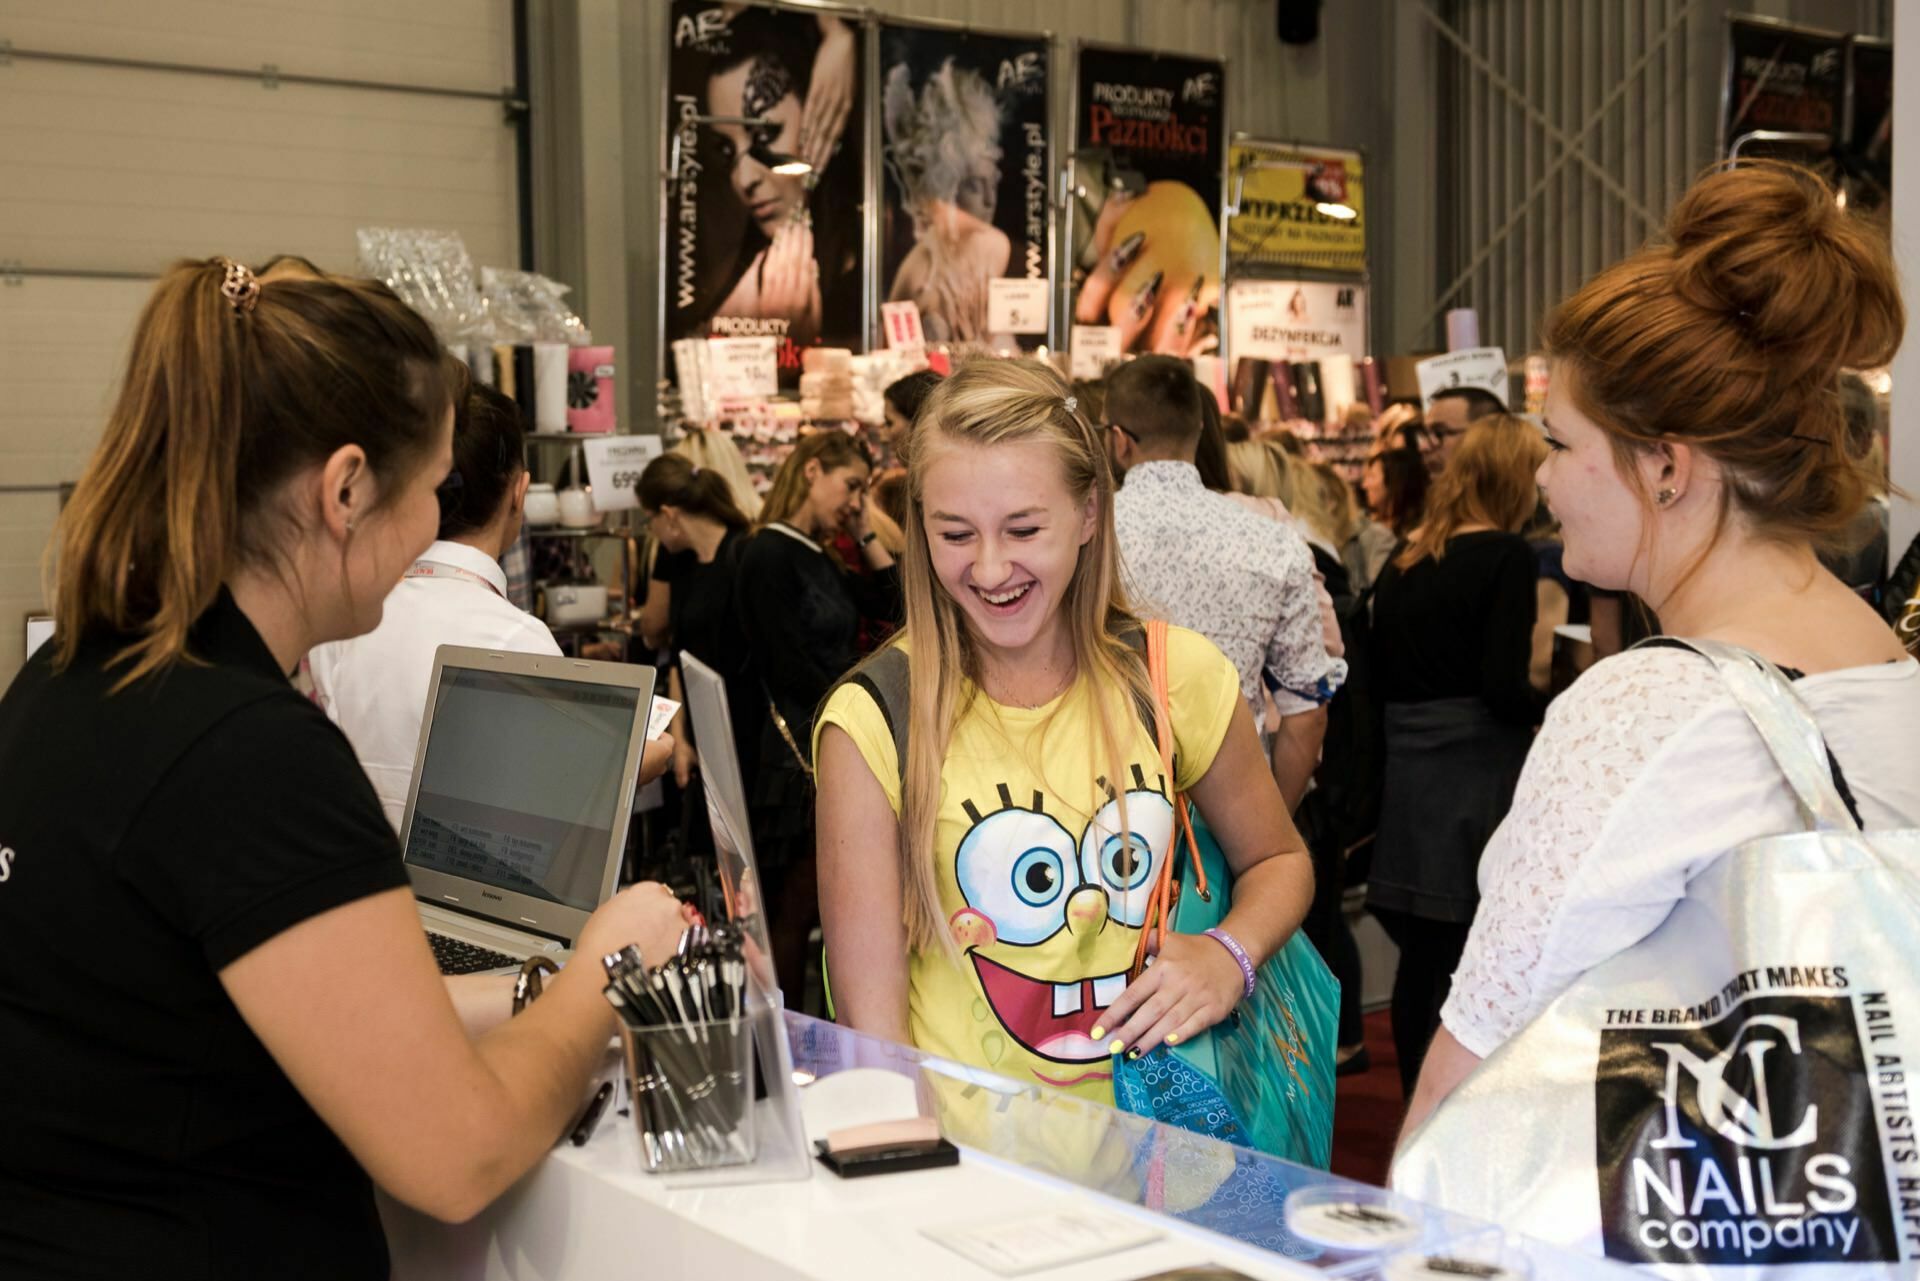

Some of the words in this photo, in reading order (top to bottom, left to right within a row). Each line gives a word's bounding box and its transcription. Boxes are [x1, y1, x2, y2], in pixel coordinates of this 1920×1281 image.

[1093, 82, 1175, 107] PRODUKTY
[1089, 104, 1208, 155] Paznokci
[481, 889, 503, 903] lenovo
[1605, 1008, 1646, 1025] THE
[1652, 996, 1722, 1025] BRAND
[1723, 970, 1761, 1010] THAT
[1767, 966, 1850, 989] MAKES
[1860, 990, 1897, 1043] NAIL
[1874, 1054, 1919, 1164] ARTISTS
[1632, 1153, 1859, 1217] NAILS
[1638, 1216, 1860, 1257] company
